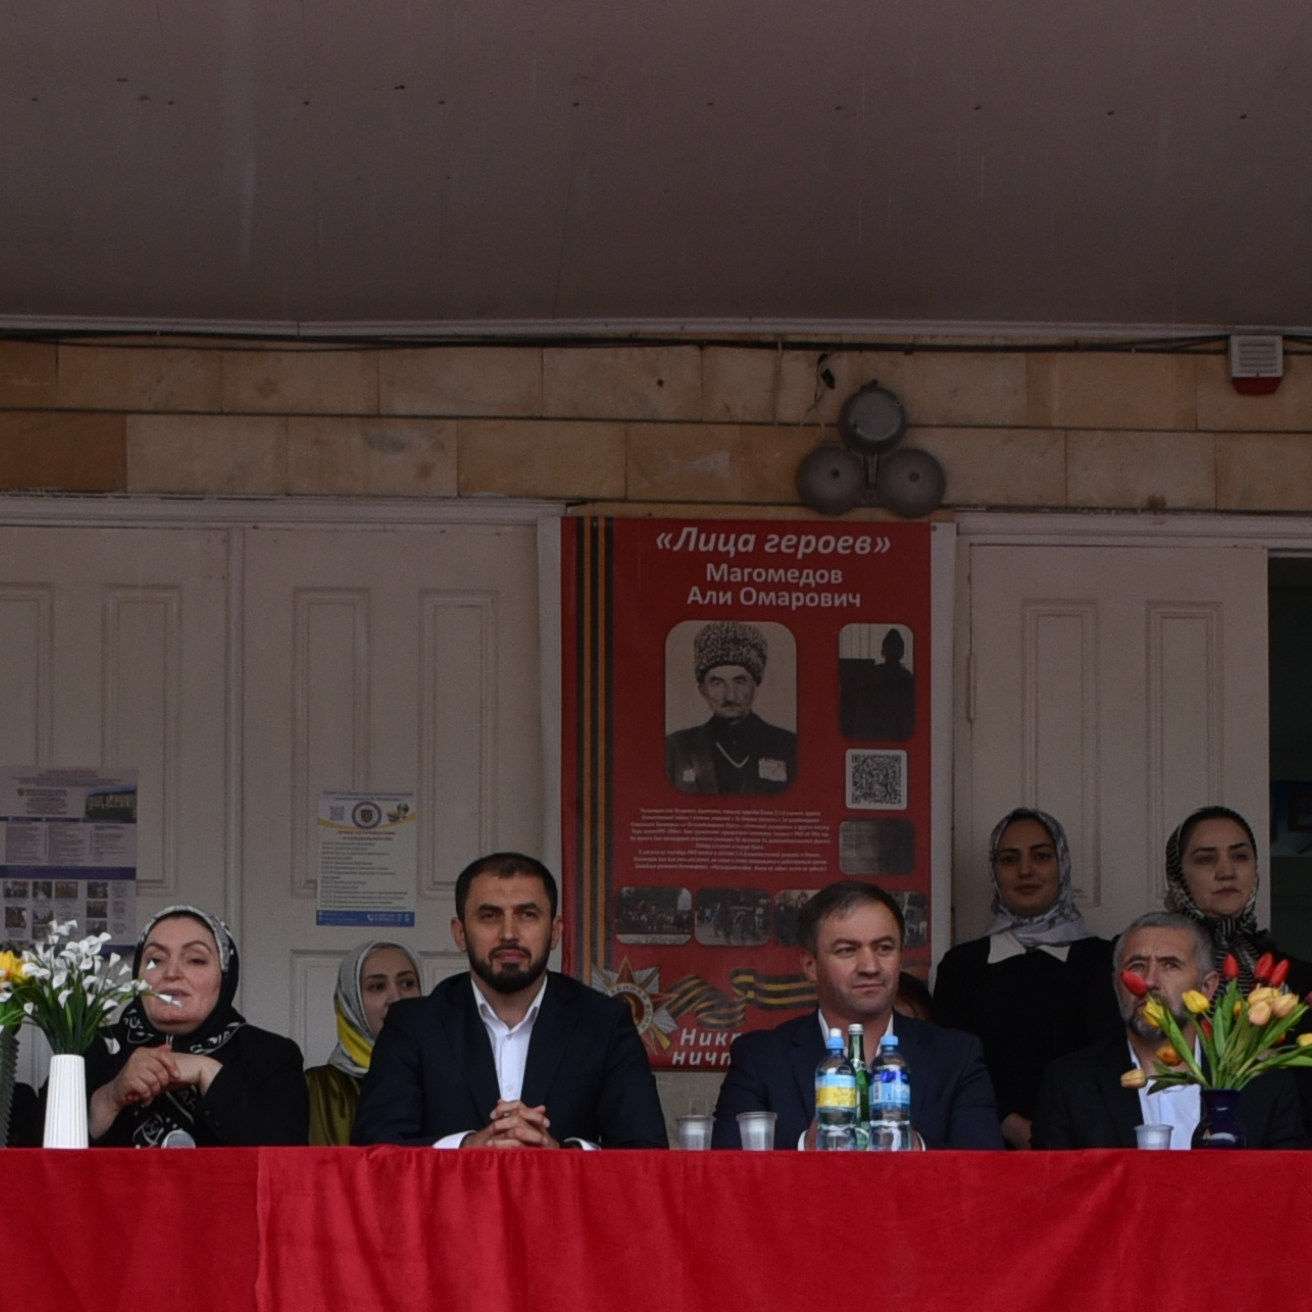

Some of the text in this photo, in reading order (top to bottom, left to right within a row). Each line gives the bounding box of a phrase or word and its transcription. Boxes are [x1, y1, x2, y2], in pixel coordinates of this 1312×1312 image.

[656, 527, 892, 559] «Лица героев»
[706, 563, 843, 586] Магомедов
[687, 586, 861, 611] Али Омарович
